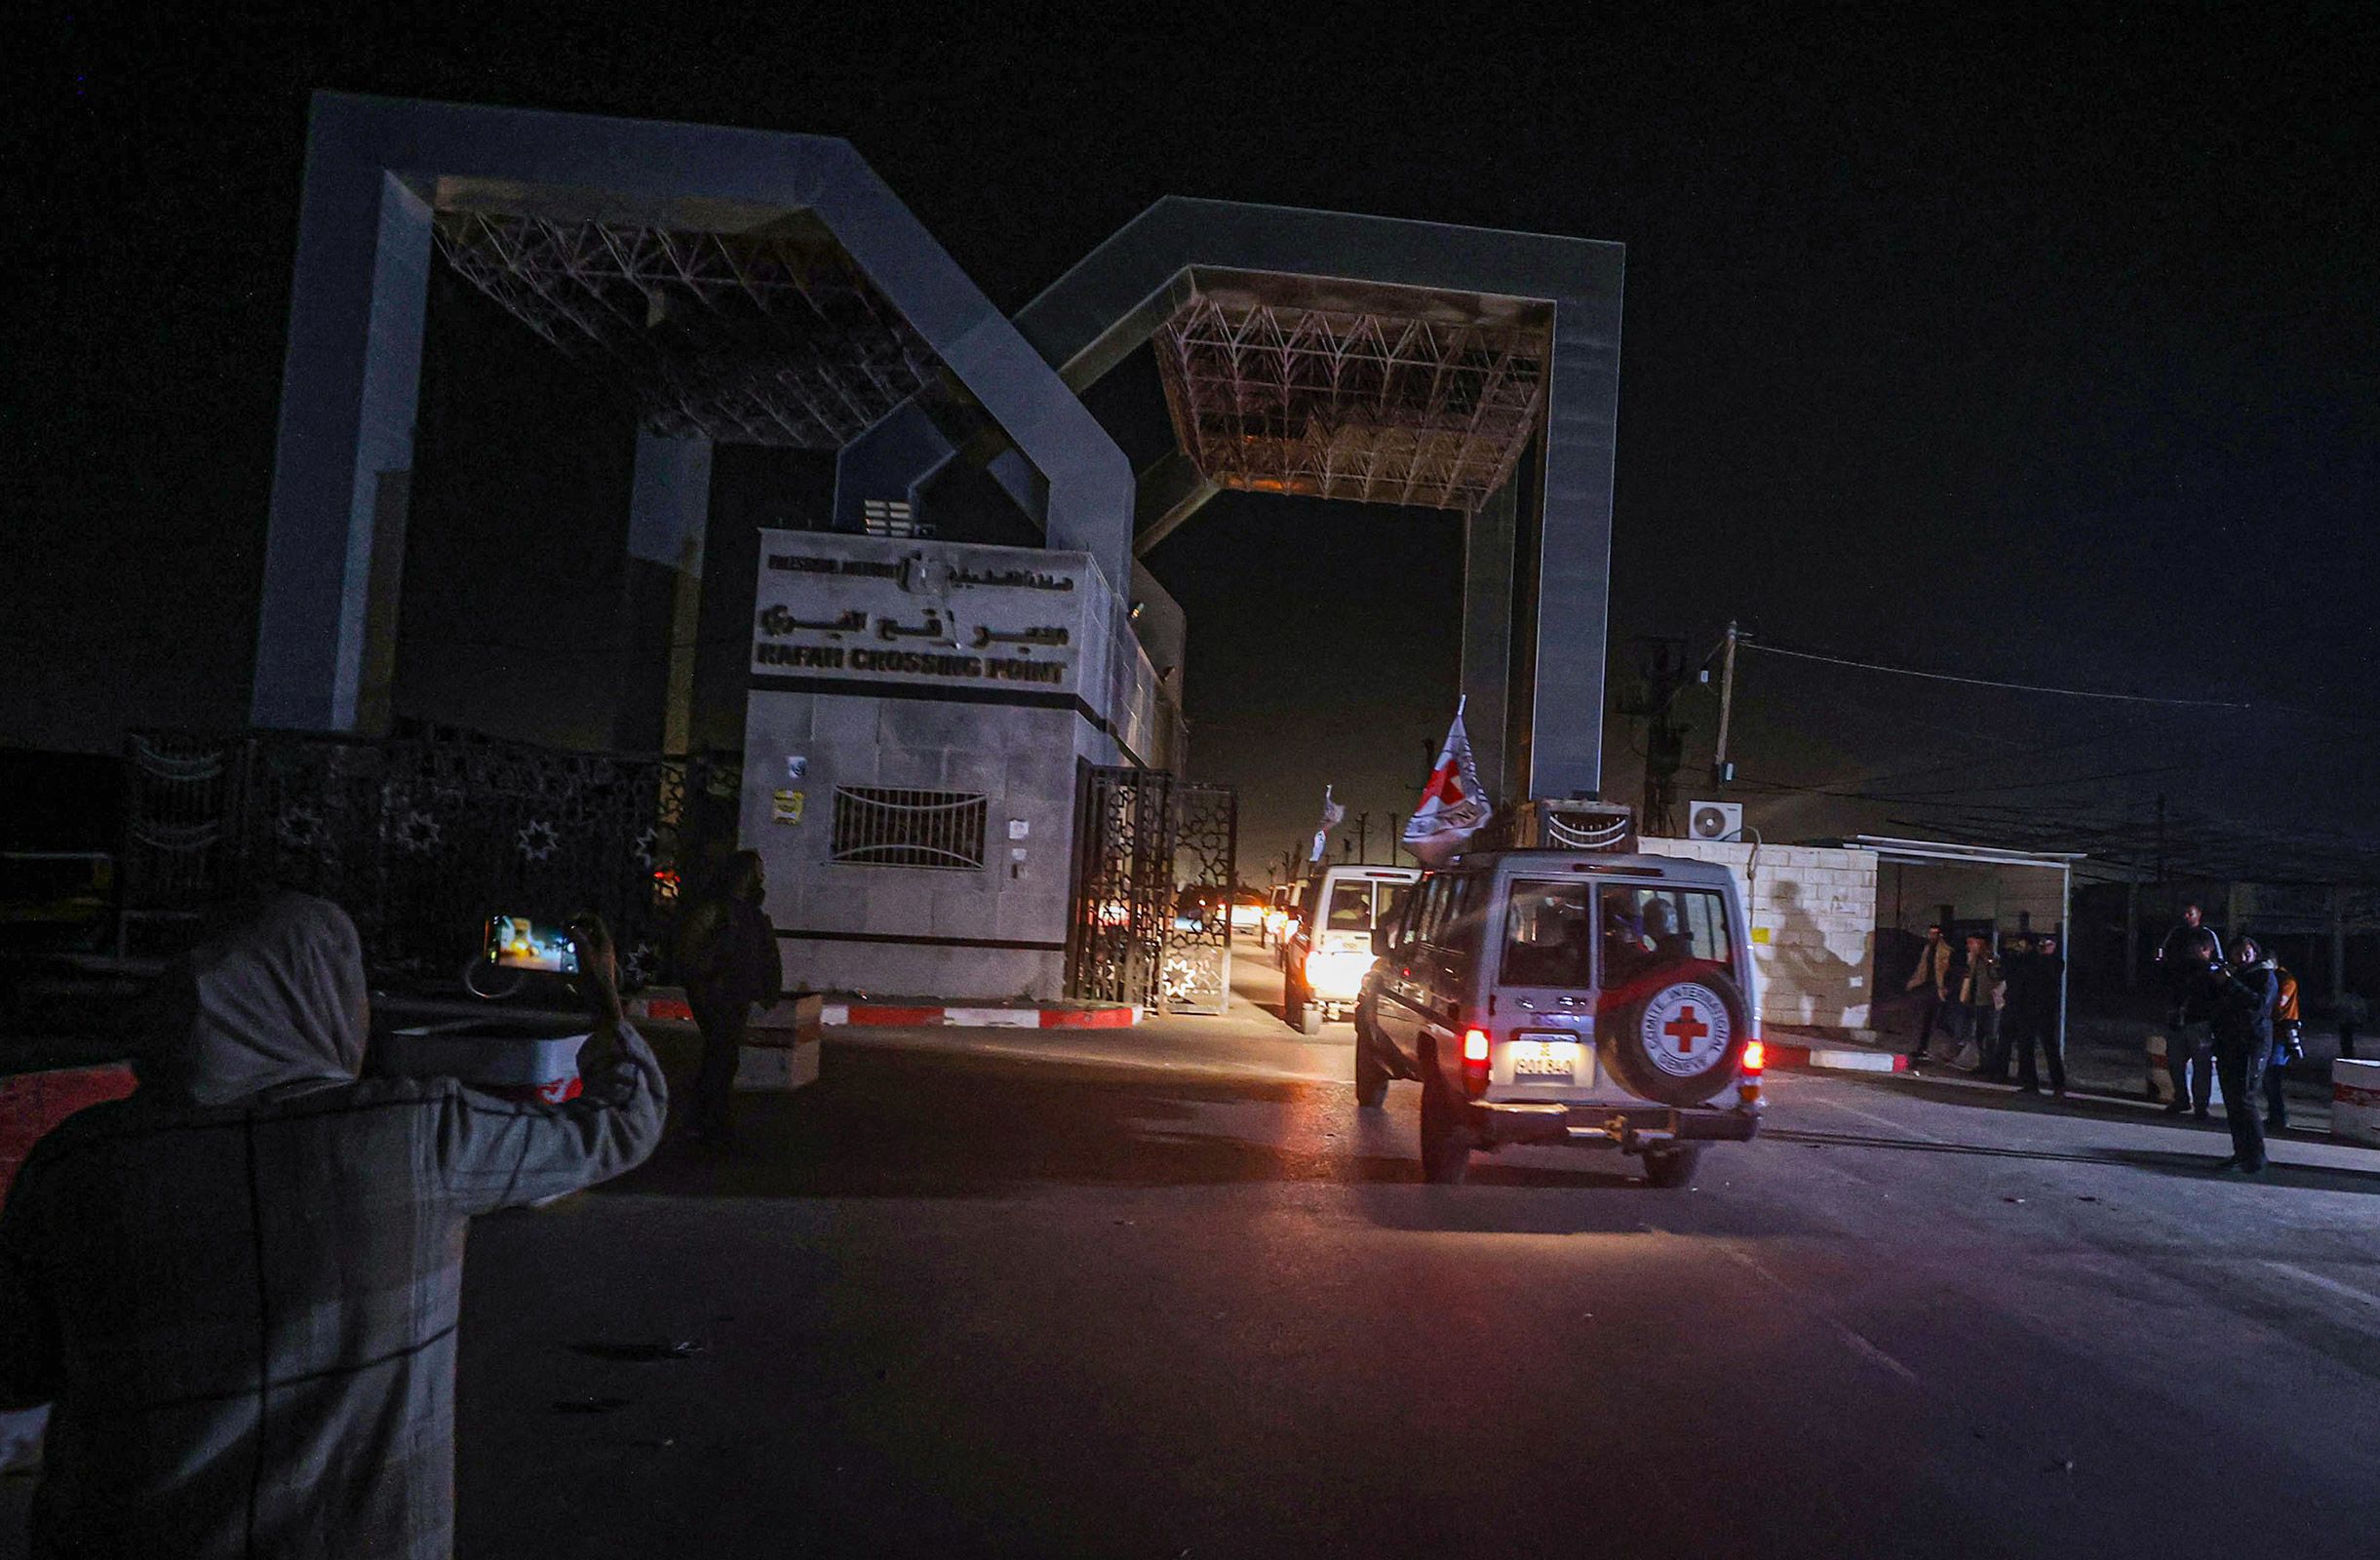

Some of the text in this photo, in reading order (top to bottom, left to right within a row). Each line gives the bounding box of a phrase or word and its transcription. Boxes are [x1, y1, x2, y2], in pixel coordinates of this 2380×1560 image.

[758, 643, 1069, 683] RAFAH CROSSING POINT
